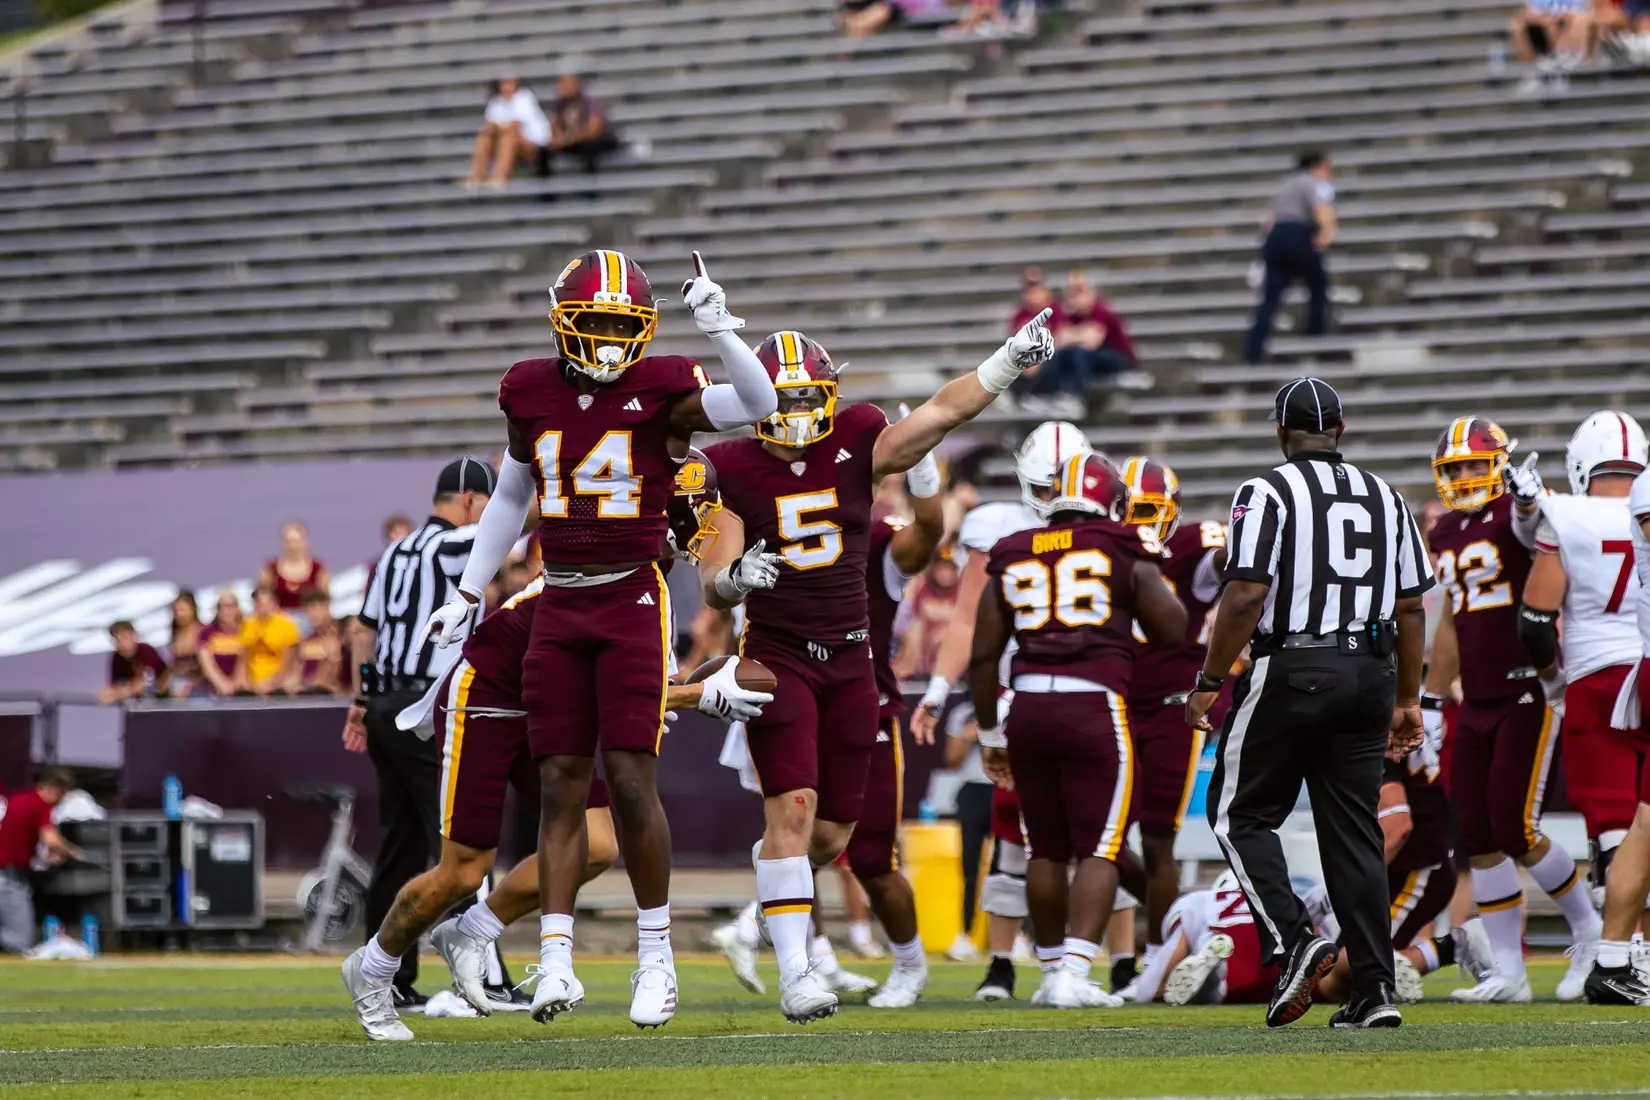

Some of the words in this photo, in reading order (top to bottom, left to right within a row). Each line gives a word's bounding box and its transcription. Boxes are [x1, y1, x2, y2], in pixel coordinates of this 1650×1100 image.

[535, 431, 643, 518] 14
[775, 487, 843, 570] 5
[1327, 501, 1372, 578] C
[387, 554, 420, 617] U
[1001, 548, 1112, 631] 96
